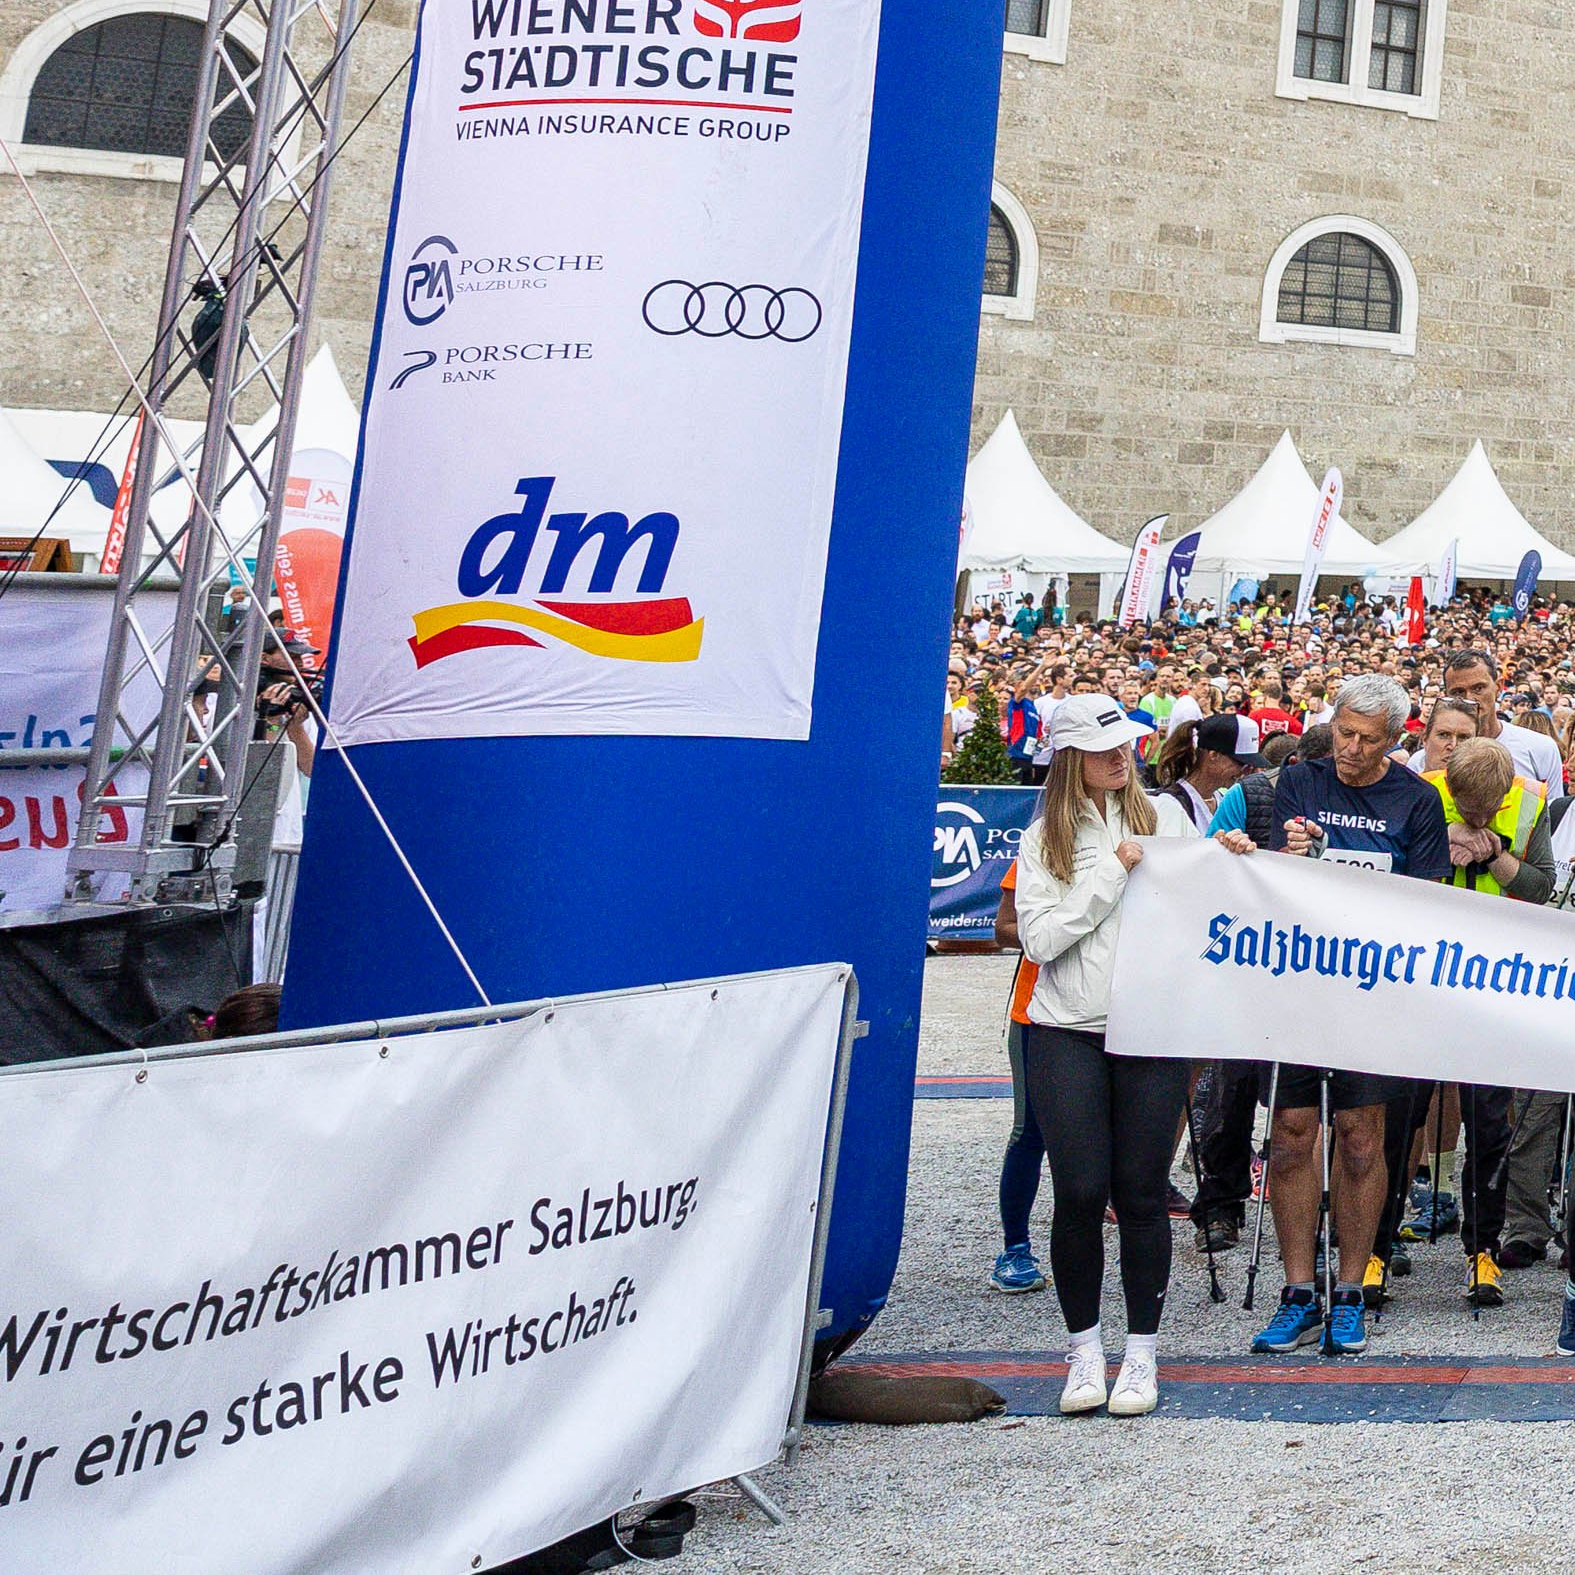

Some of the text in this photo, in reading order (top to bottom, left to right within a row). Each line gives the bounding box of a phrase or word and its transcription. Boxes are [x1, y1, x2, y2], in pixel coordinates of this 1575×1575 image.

[460, 43, 798, 97] STÄDTISCHE
[456, 114, 791, 143] VIENNA INSURANCE GROUP
[458, 255, 604, 276] PORSCHE
[456, 278, 548, 294] SALZBURG
[445, 343, 594, 365] PORSCHE
[441, 369, 497, 384] BANK
[456, 476, 681, 597] dm
[1317, 811, 1387, 832] SIEMENS
[1199, 913, 1427, 992] Salzburger
[74, 1409, 208, 1486] eine
[223, 1351, 404, 1447] starke
[425, 1275, 639, 1391] Wirtschaft.
